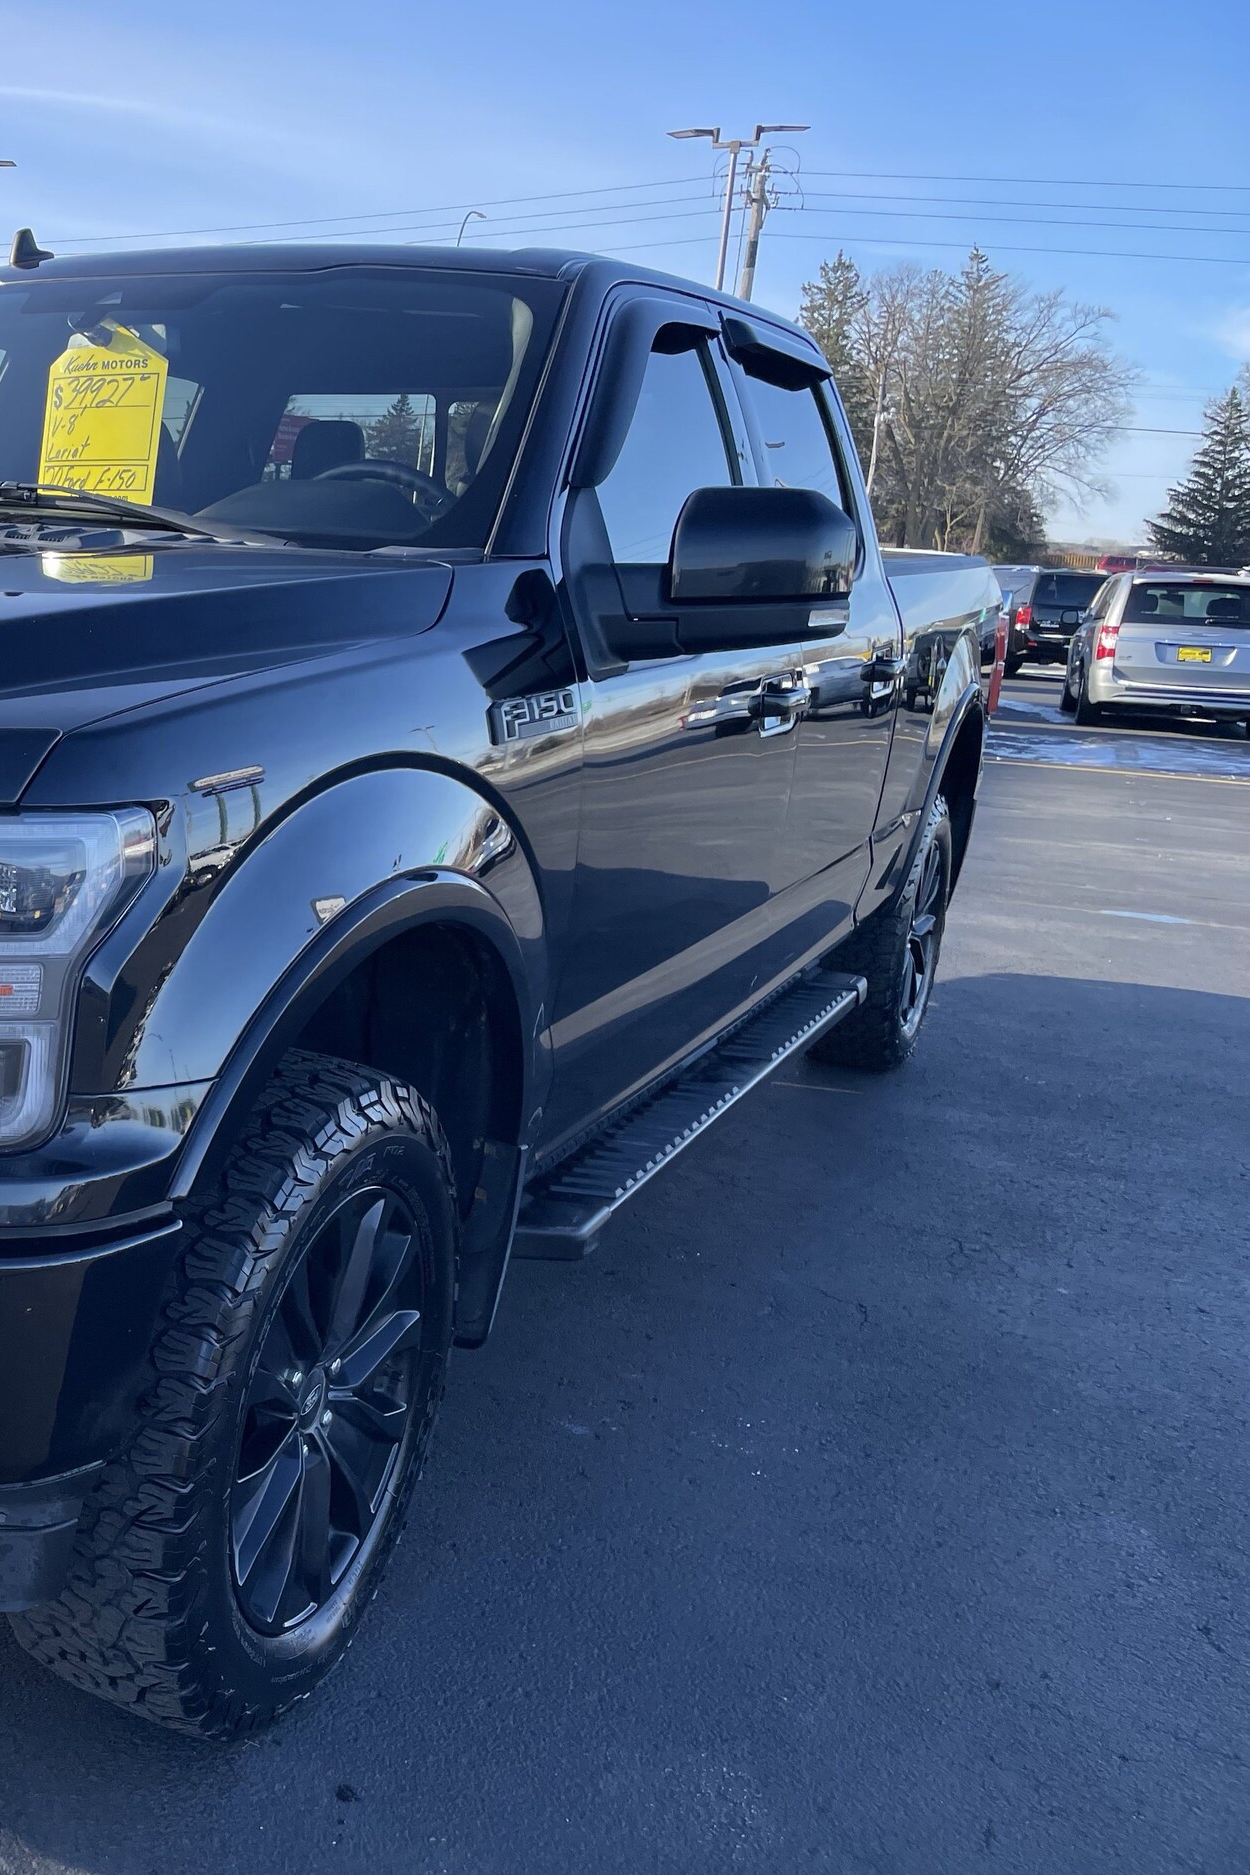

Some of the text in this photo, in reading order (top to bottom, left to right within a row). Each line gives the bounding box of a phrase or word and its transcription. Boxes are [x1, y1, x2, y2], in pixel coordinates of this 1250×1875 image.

[64, 354, 149, 374] Kuehn MOTORS
[52, 413, 79, 437] V-8
[47, 434, 91, 461] Lariat
[62, 465, 91, 491] Ford
